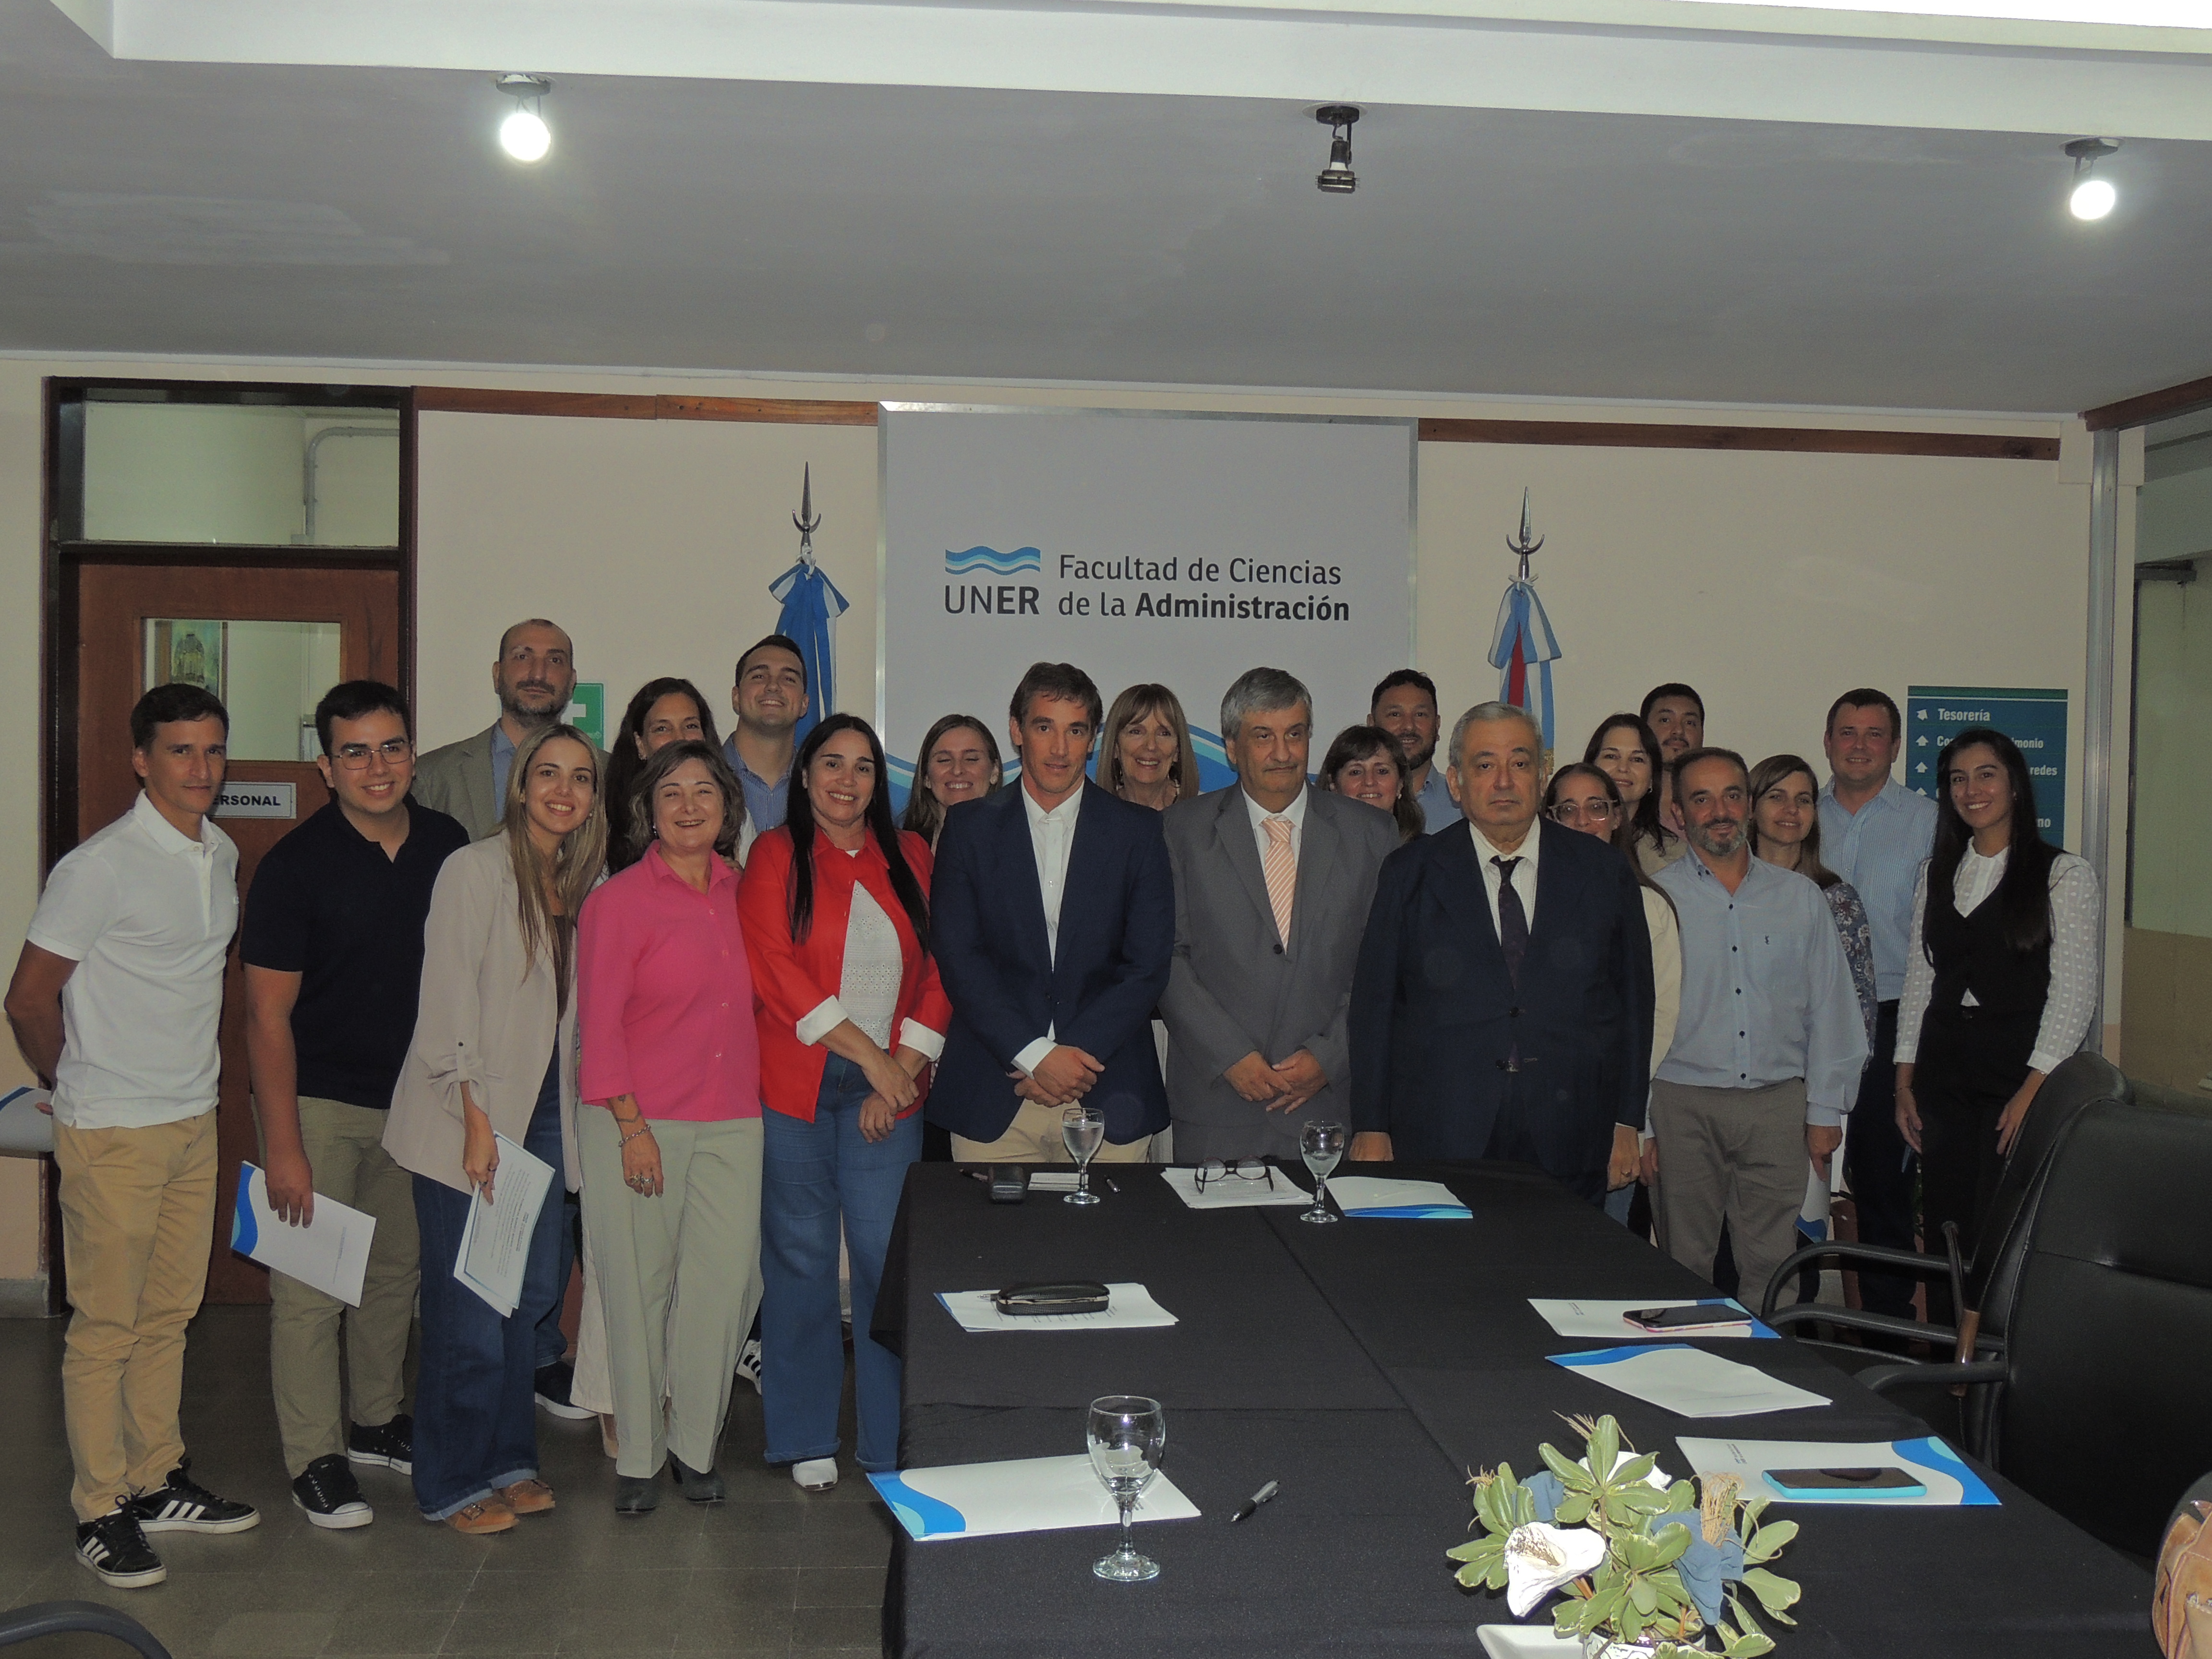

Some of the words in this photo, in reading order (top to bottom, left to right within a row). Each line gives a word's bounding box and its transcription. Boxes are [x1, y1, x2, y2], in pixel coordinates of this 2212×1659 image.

[1059, 554, 1178, 582] Facultad
[1188, 557, 1219, 582] de
[1229, 557, 1342, 585] Ciencias
[945, 585, 1041, 615] UNER
[1058, 591, 1090, 616] de
[1099, 591, 1126, 617] la
[1135, 592, 1350, 621] Administración
[1937, 708, 1991, 721] Tesorería
[2030, 764, 2058, 776] redes
[212, 794, 281, 806] ERSONAL
